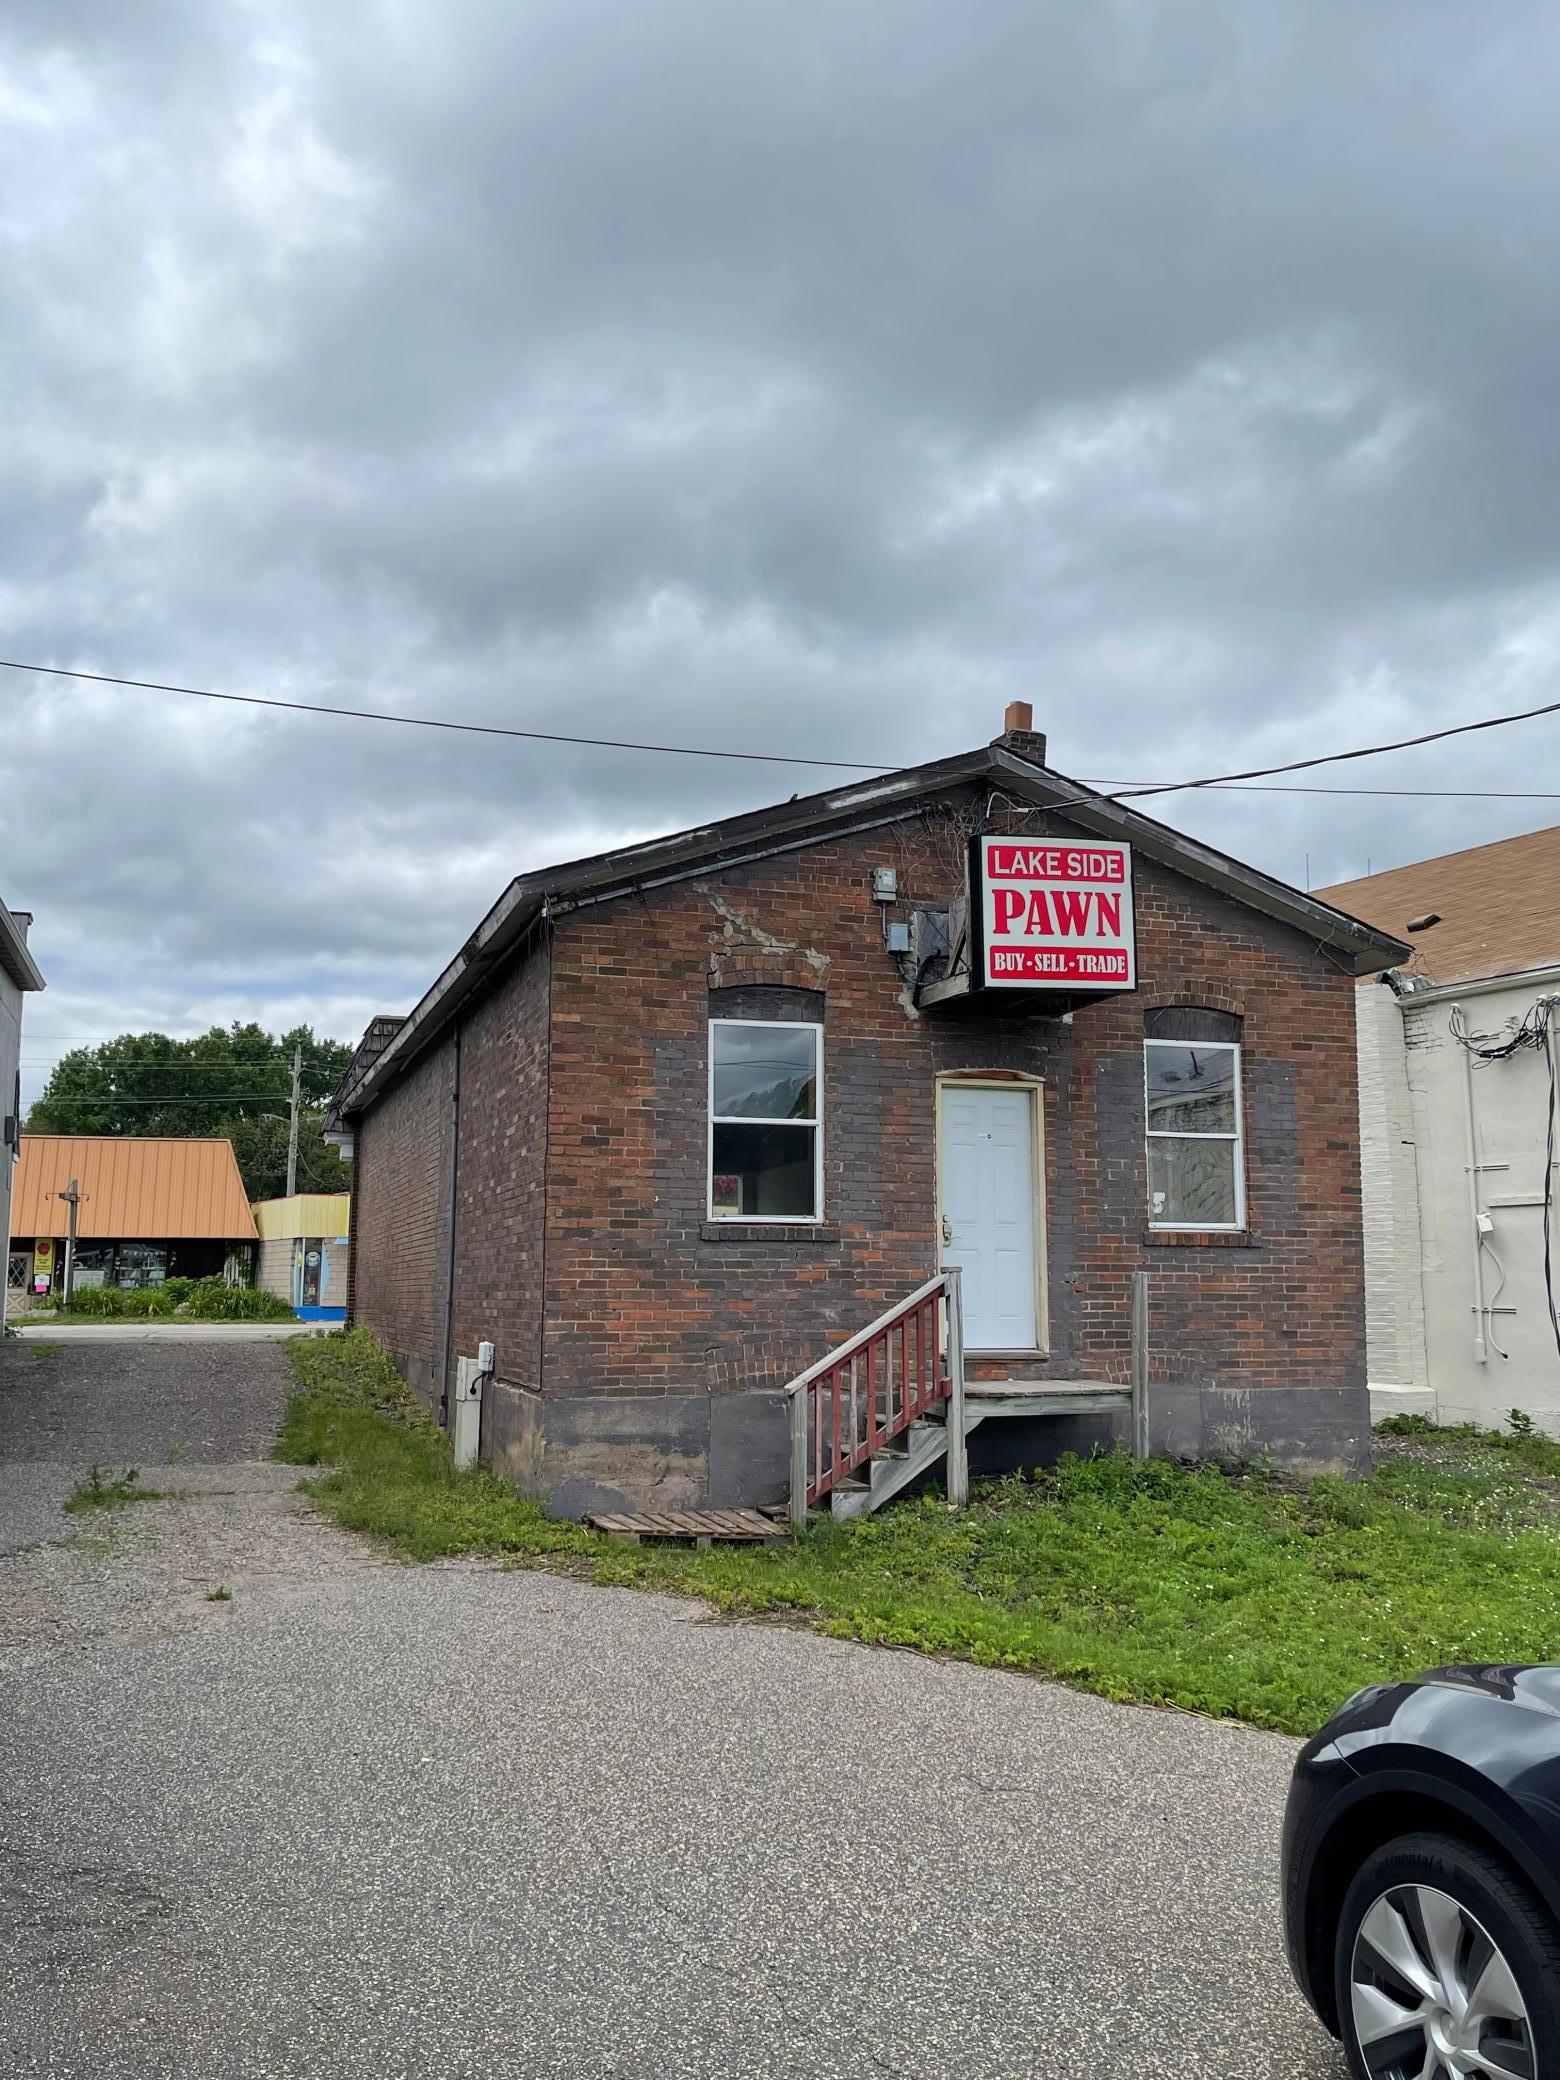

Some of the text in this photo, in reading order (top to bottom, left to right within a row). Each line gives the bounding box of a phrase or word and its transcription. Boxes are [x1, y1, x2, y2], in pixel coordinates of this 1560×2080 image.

[994, 850, 1121, 878] LAKE SIDE
[992, 889, 1121, 937] PAWN
[994, 953, 1125, 974] BUY SELL TRADE
